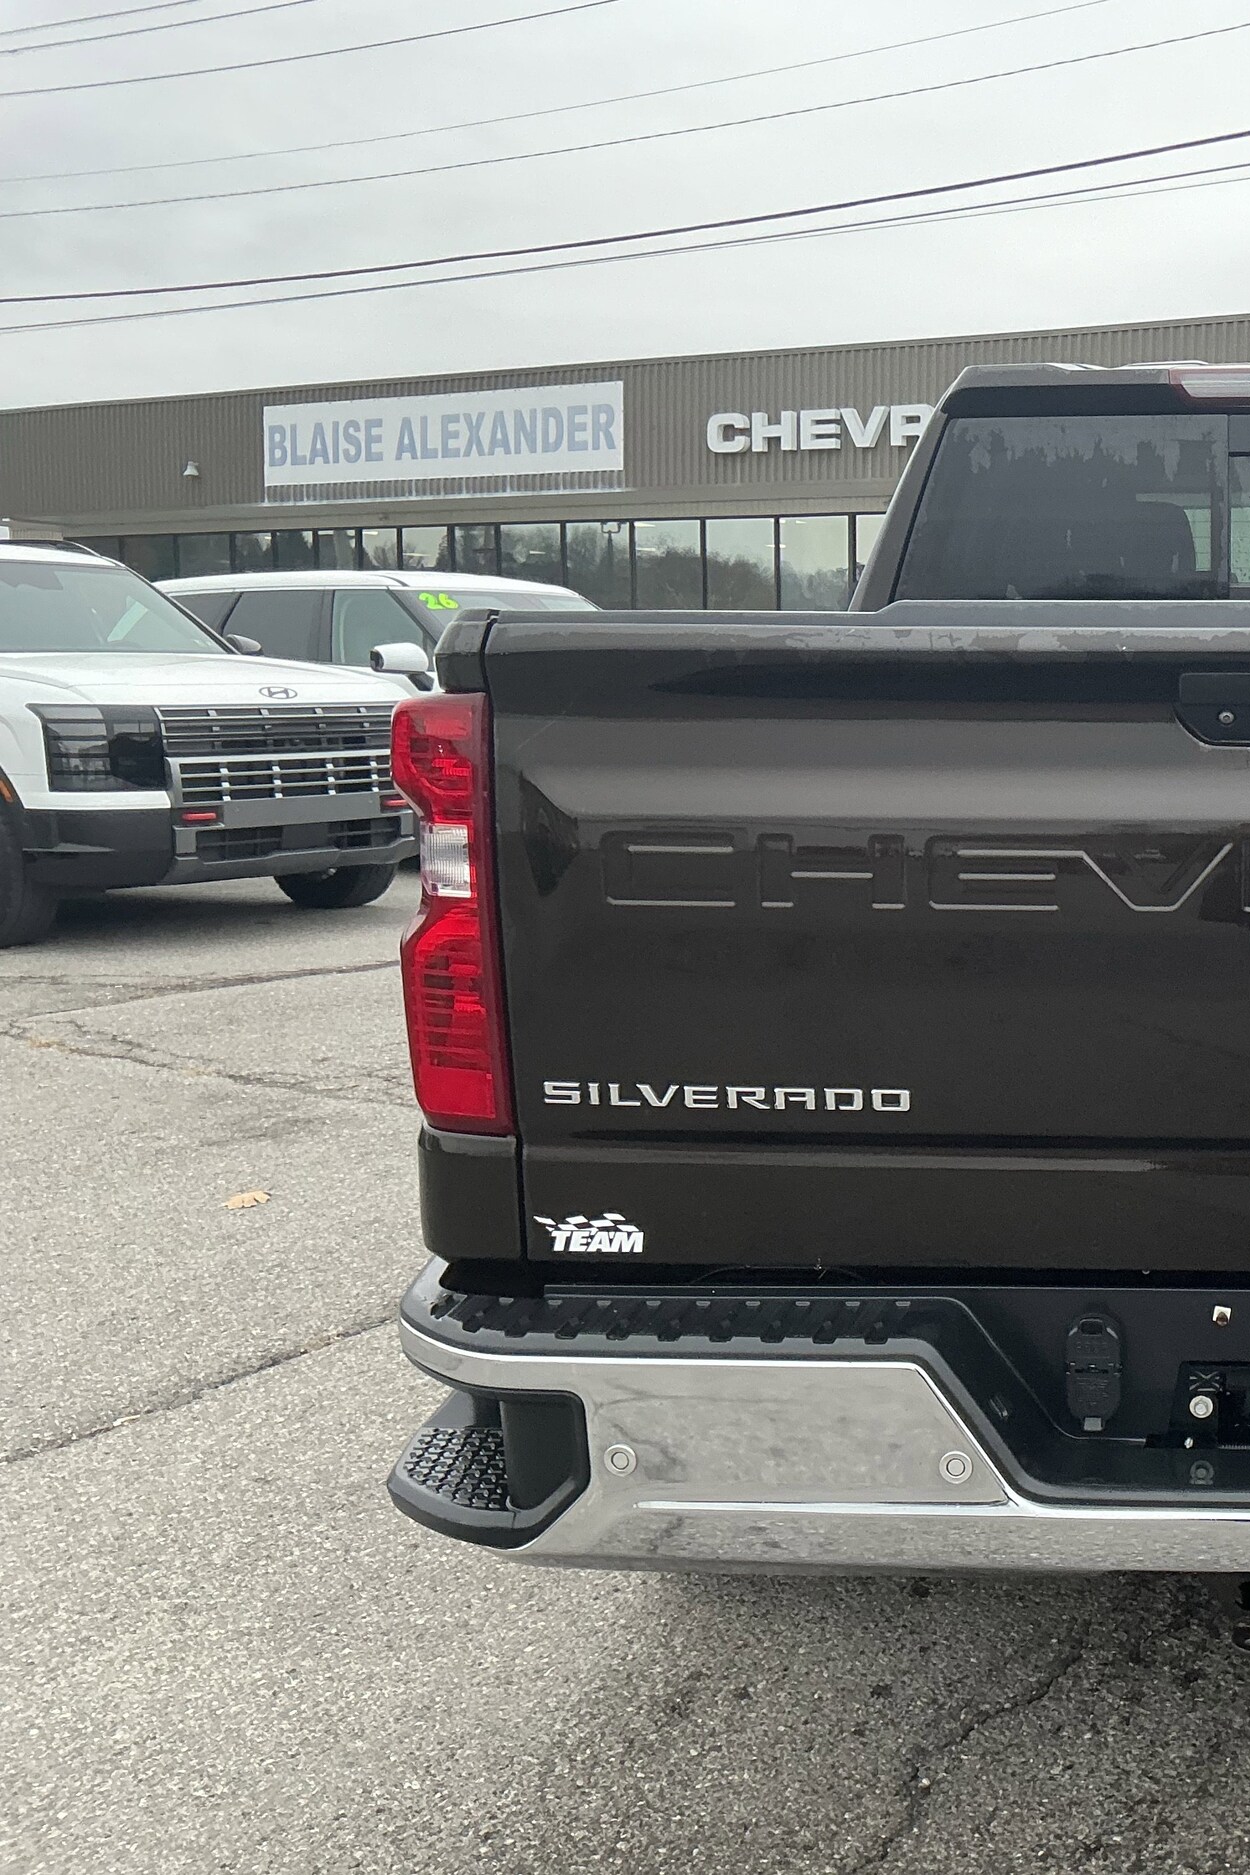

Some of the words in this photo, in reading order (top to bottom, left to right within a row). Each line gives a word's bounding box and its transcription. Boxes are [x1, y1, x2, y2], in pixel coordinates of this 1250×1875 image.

[268, 418, 384, 467] BLAISE
[395, 403, 616, 461] ALEXANDER
[418, 592, 459, 609] 26
[543, 1080, 911, 1112] SILVERADO
[551, 1230, 644, 1253] TEAM
